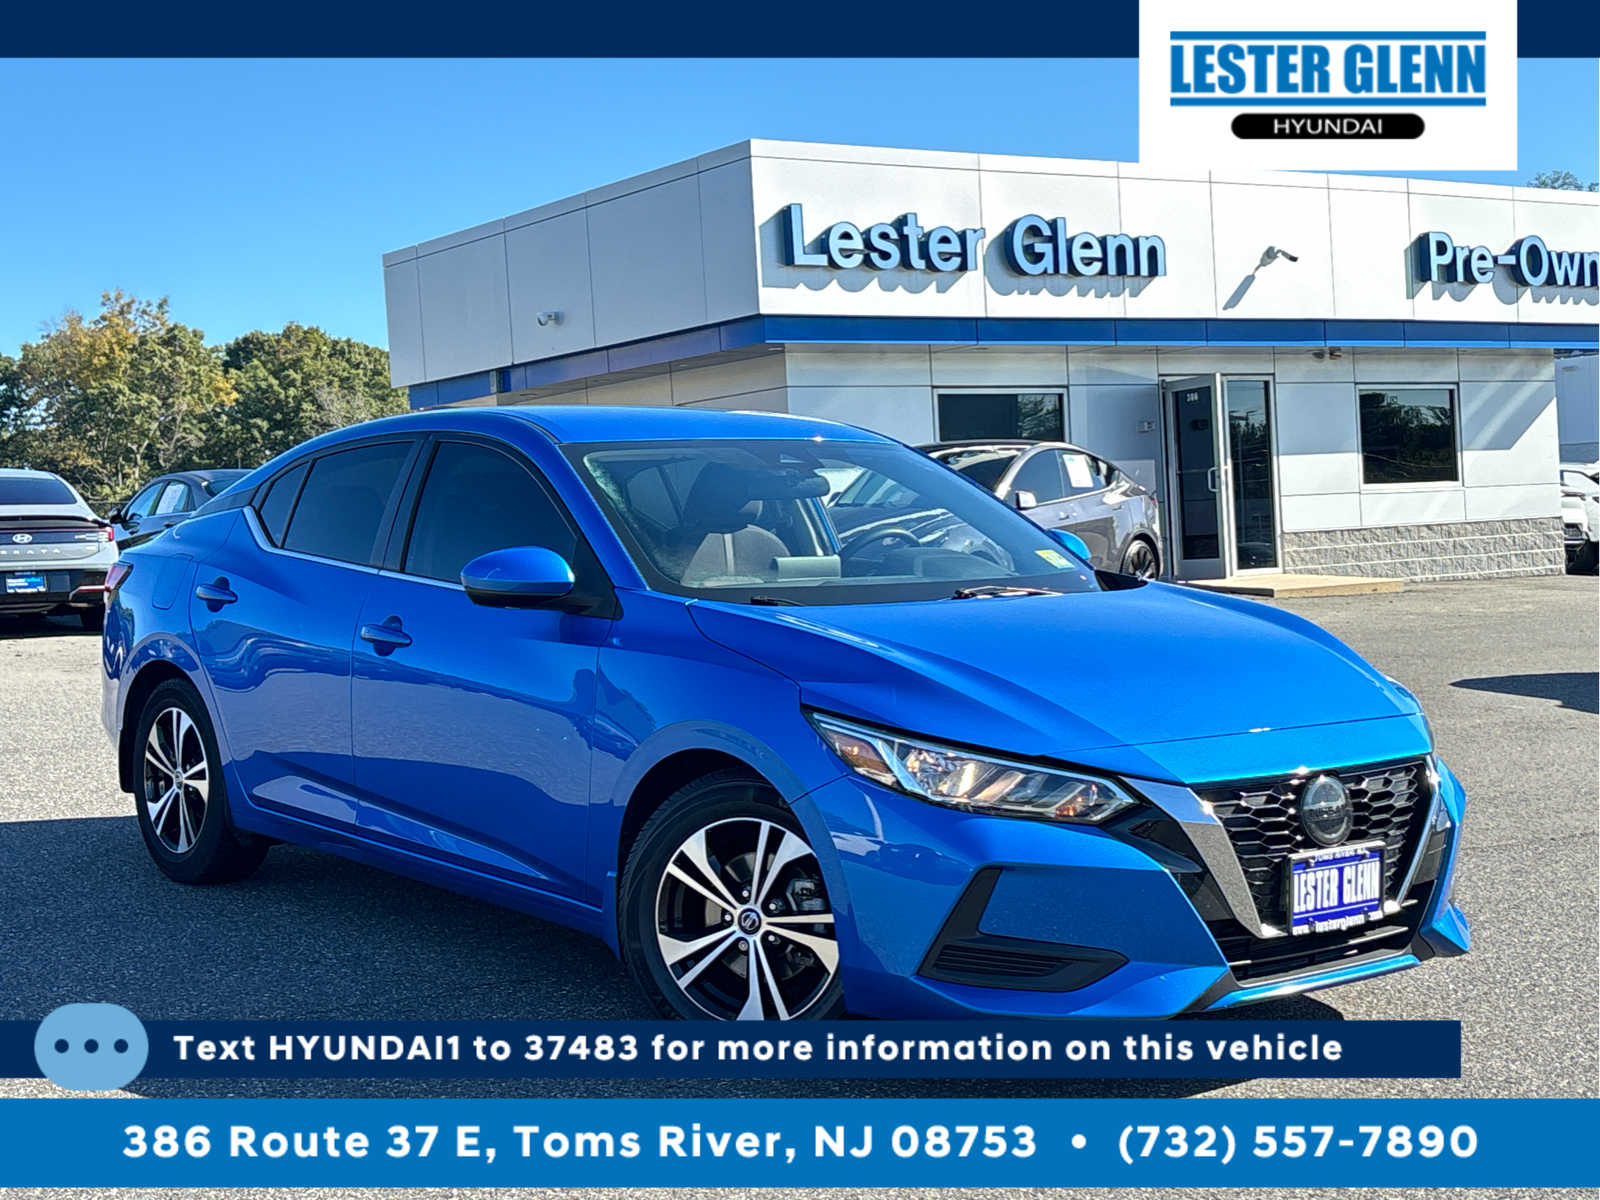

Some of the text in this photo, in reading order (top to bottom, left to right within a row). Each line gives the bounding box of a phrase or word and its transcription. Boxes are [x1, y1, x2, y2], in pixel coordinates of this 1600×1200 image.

[786, 203, 1167, 277] Lester Glenn
[1427, 231, 1600, 288] Pre-Own
[1293, 862, 1379, 913] LESTER GLENN
